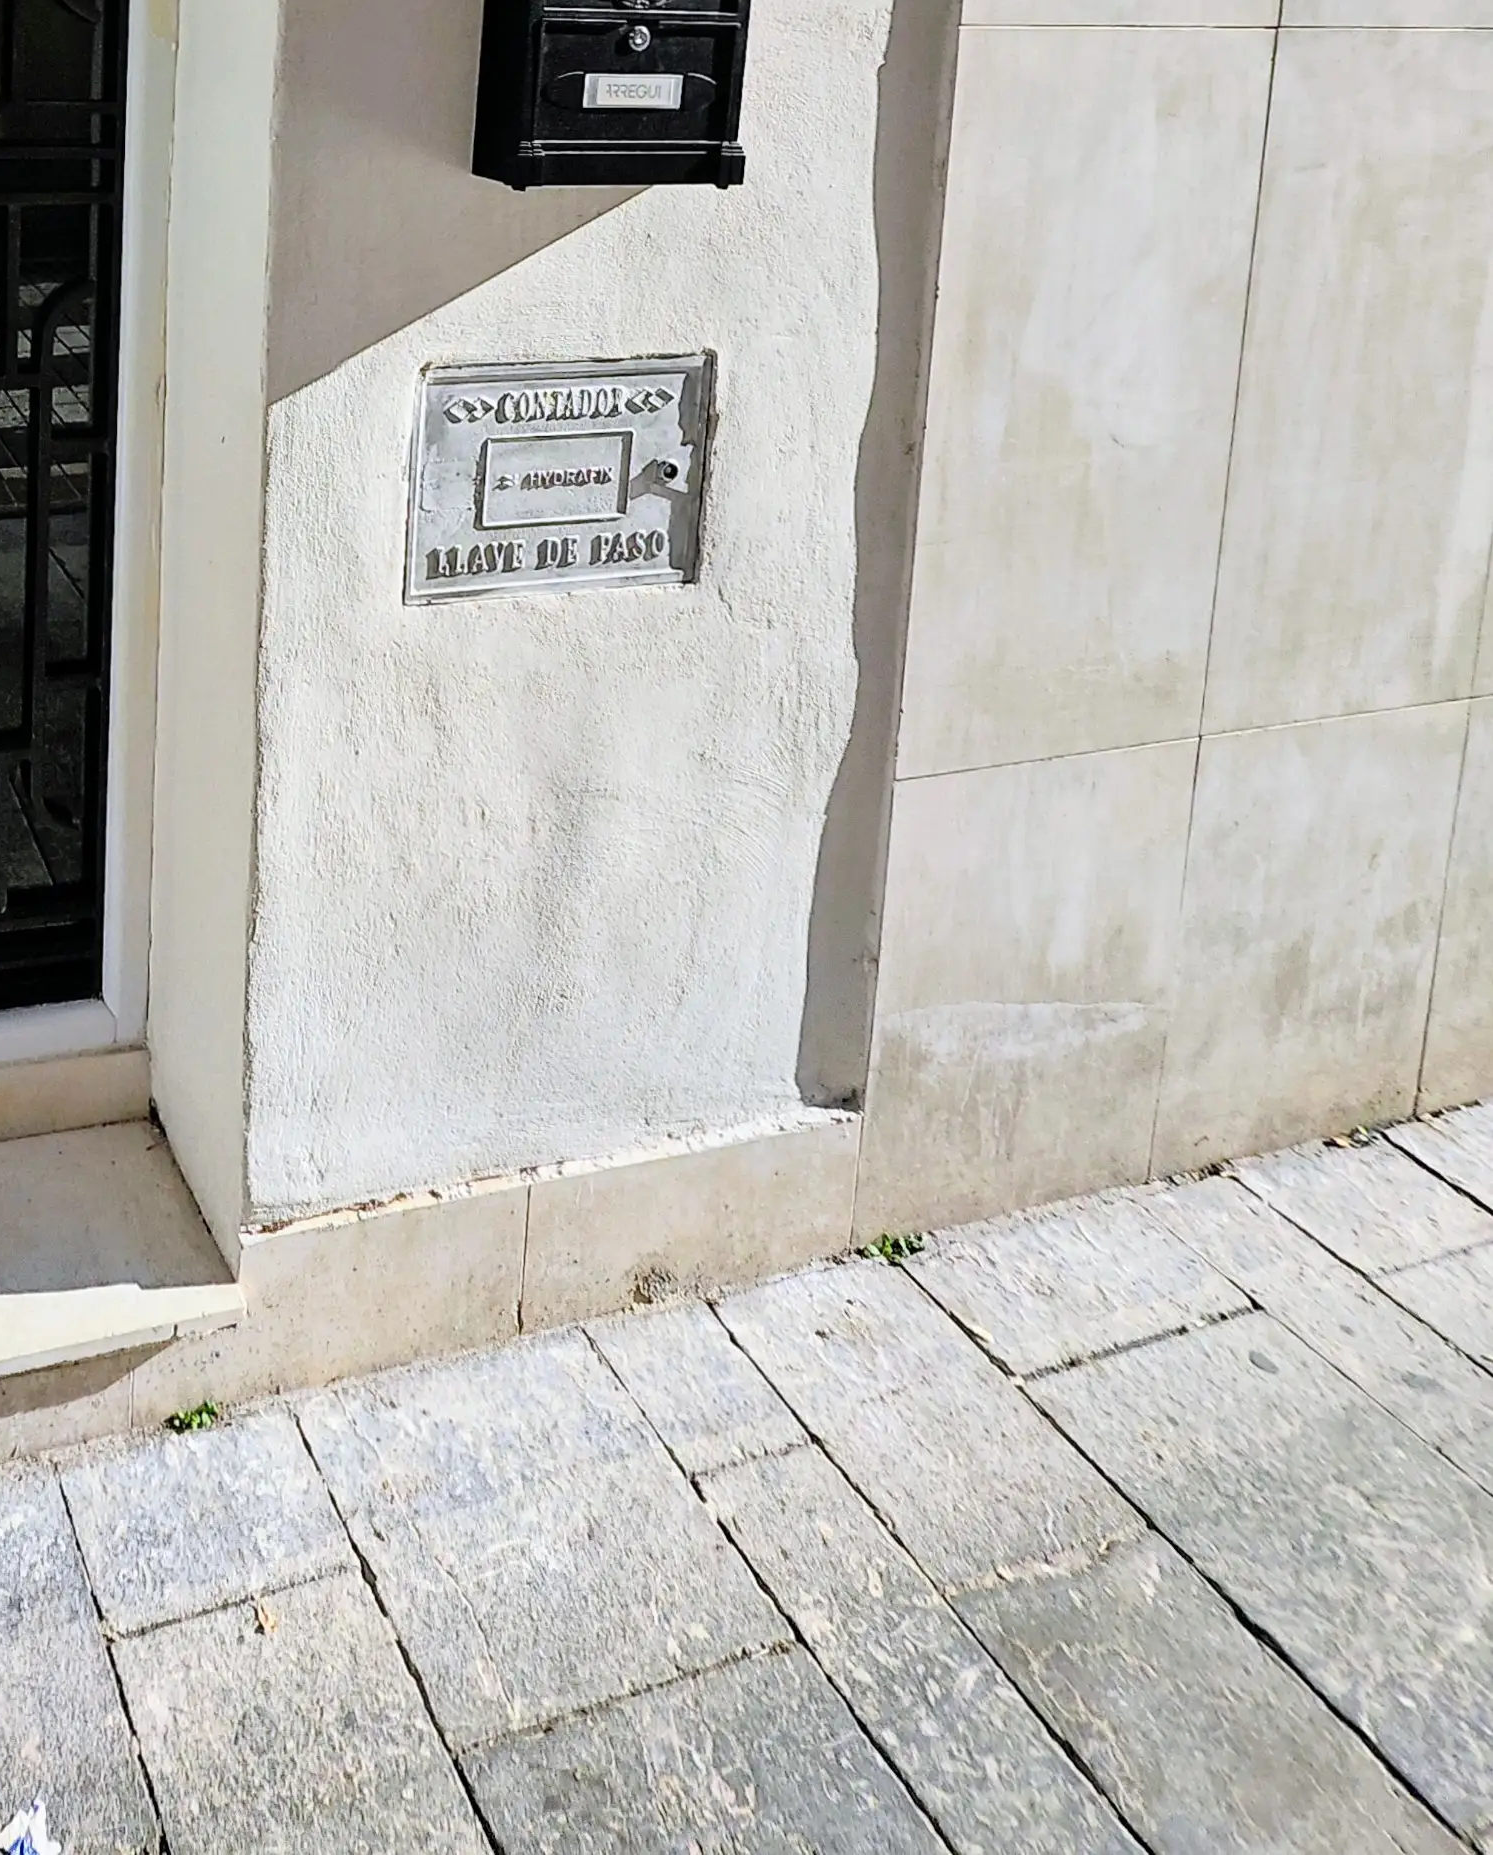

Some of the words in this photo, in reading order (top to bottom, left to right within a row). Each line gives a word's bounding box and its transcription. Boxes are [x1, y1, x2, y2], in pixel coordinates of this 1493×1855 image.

[605, 83, 662, 99] ARREGUI
[496, 387, 625, 423] CONTADOR
[427, 539, 524, 579] LLAVE
[537, 535, 580, 570] DE
[590, 530, 668, 565] PASO
